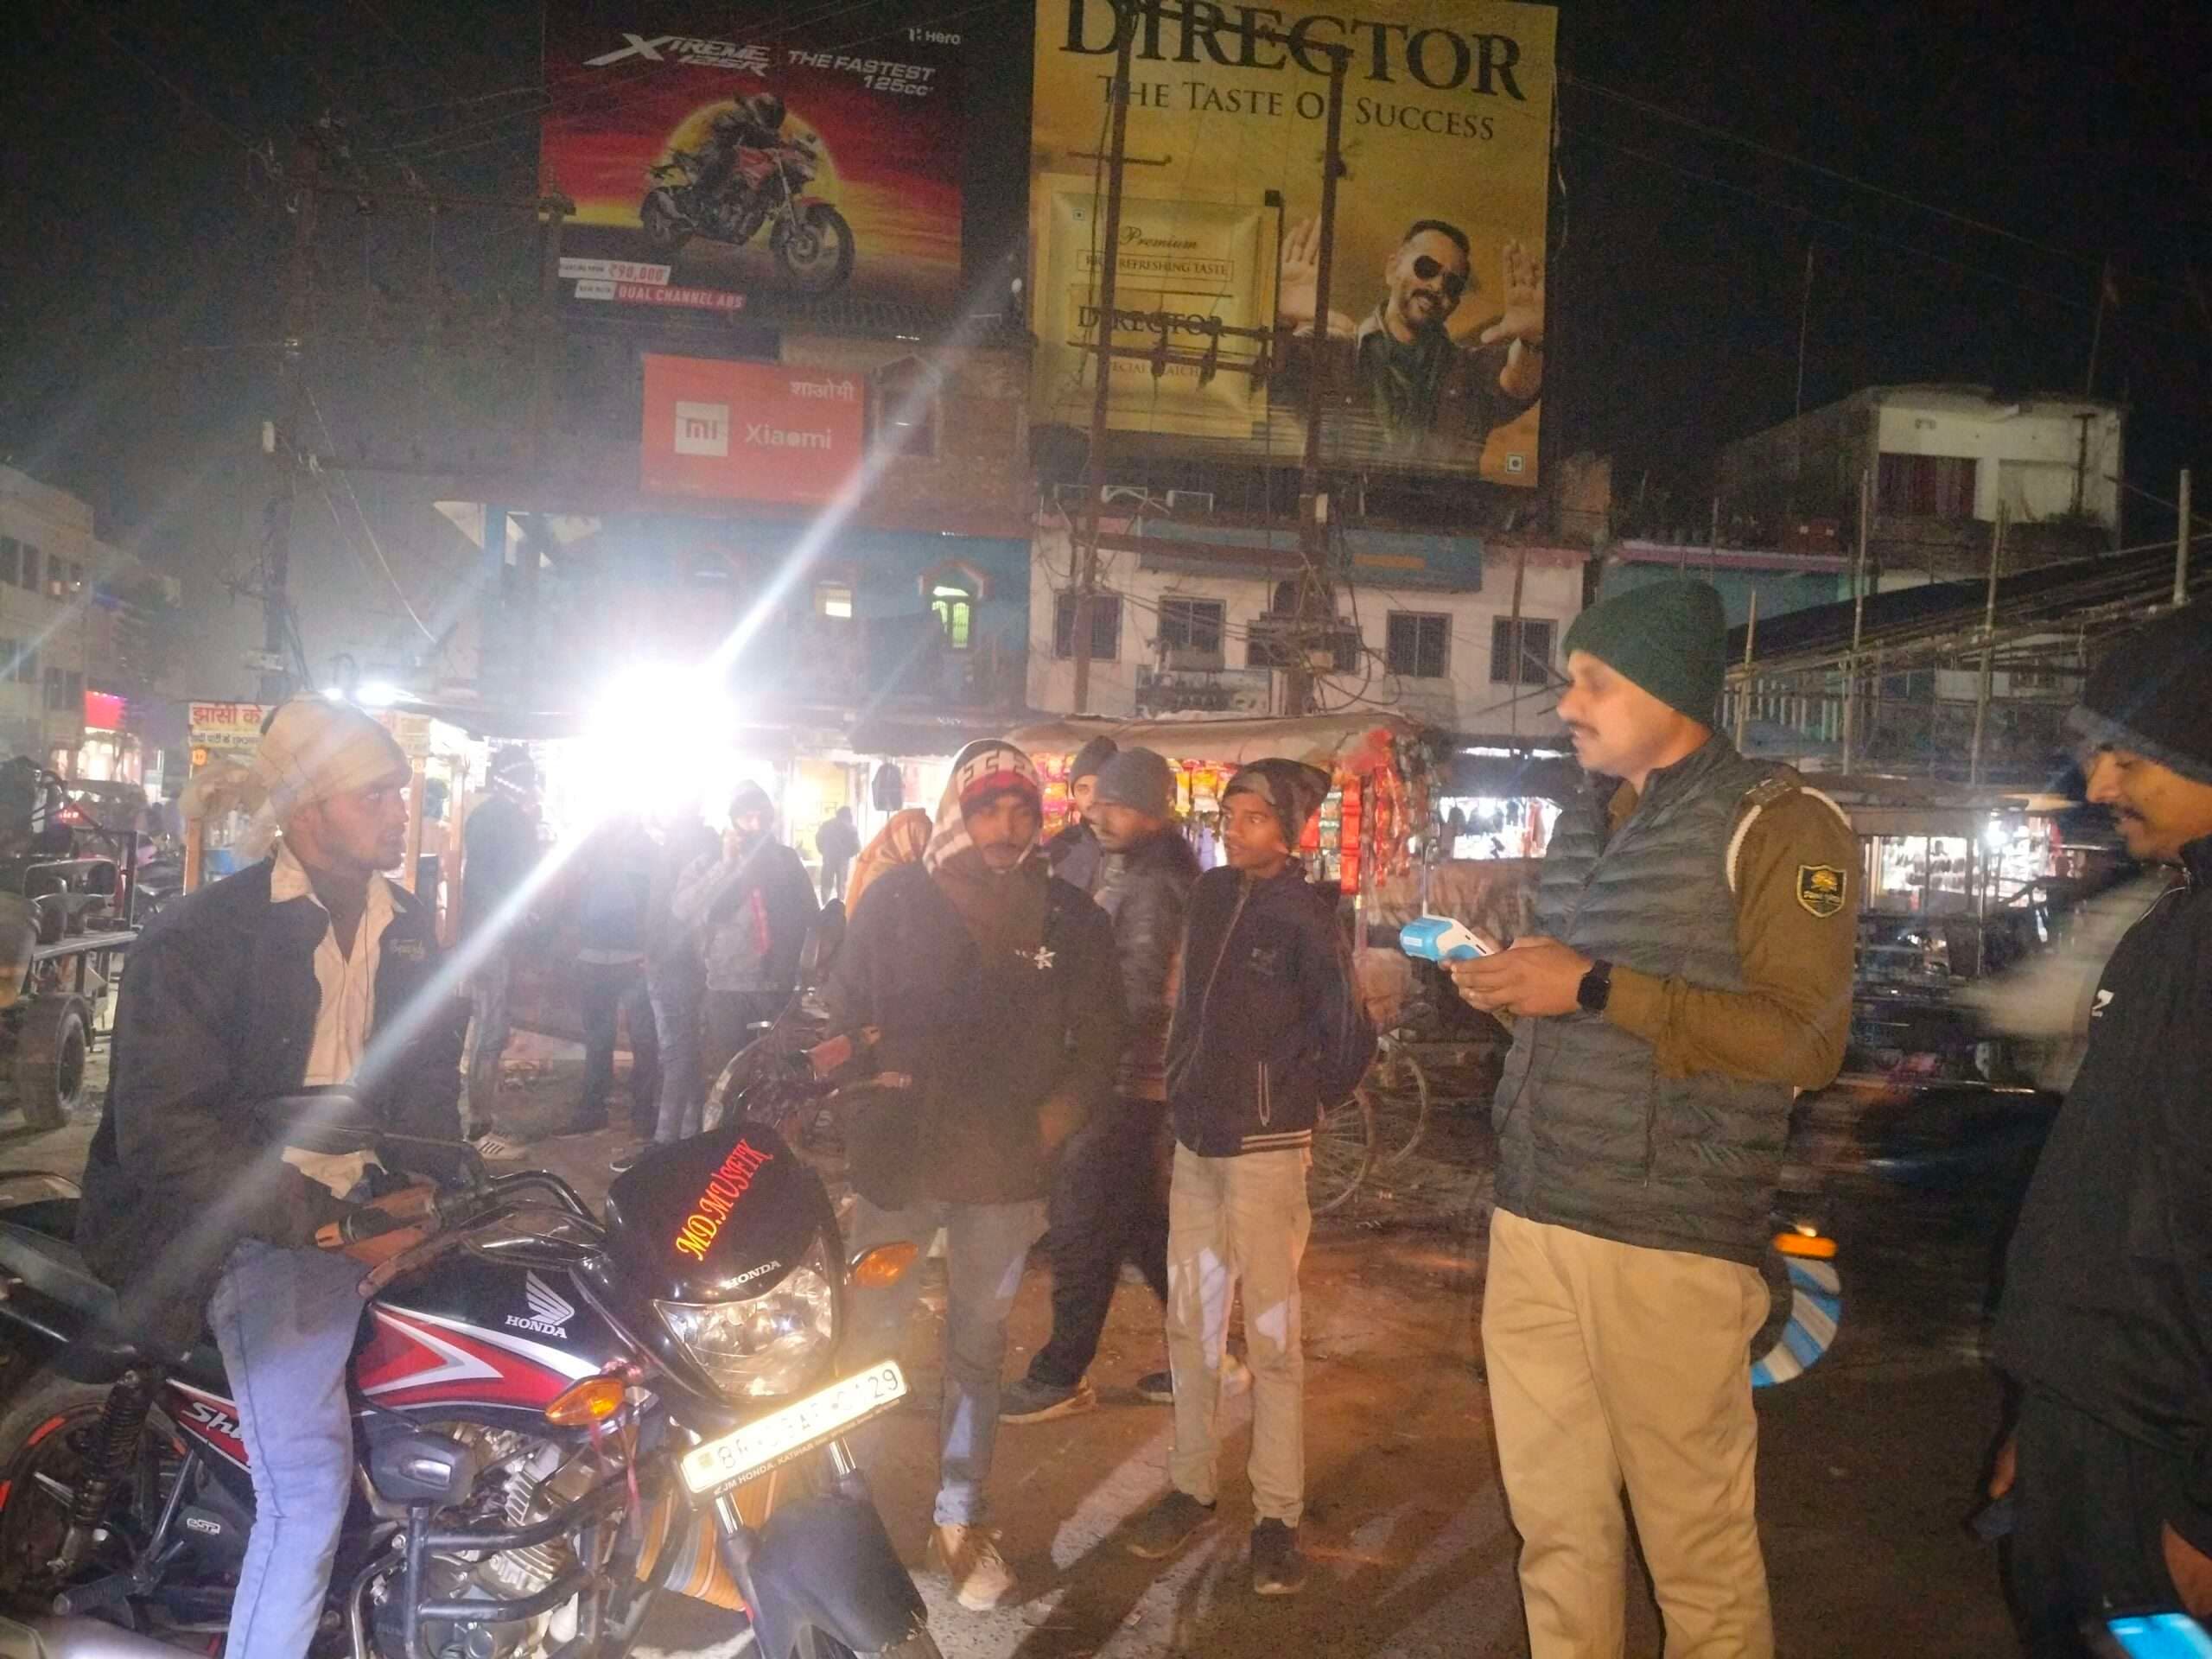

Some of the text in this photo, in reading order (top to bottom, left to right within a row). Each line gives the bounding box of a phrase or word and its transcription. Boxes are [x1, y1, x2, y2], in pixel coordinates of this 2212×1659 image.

[582, 33, 771, 67] XTREME
[925, 30, 962, 45] Hero
[1059, 0, 1526, 101] DIRECTOR
[788, 50, 936, 81] THE FASTEST
[1096, 75, 1169, 108] THE
[1182, 81, 1284, 117] TASTE
[1356, 97, 1494, 141] SUCCESS
[1119, 226, 1198, 250] Premium
[618, 284, 652, 301] DUAL
[655, 289, 713, 306] CHANNEL
[1077, 305, 1227, 338] DRECTOR
[745, 423, 832, 449] Xiaomi
[721, 1260, 782, 1290] HONDA
[505, 1314, 568, 1338] HONDA
